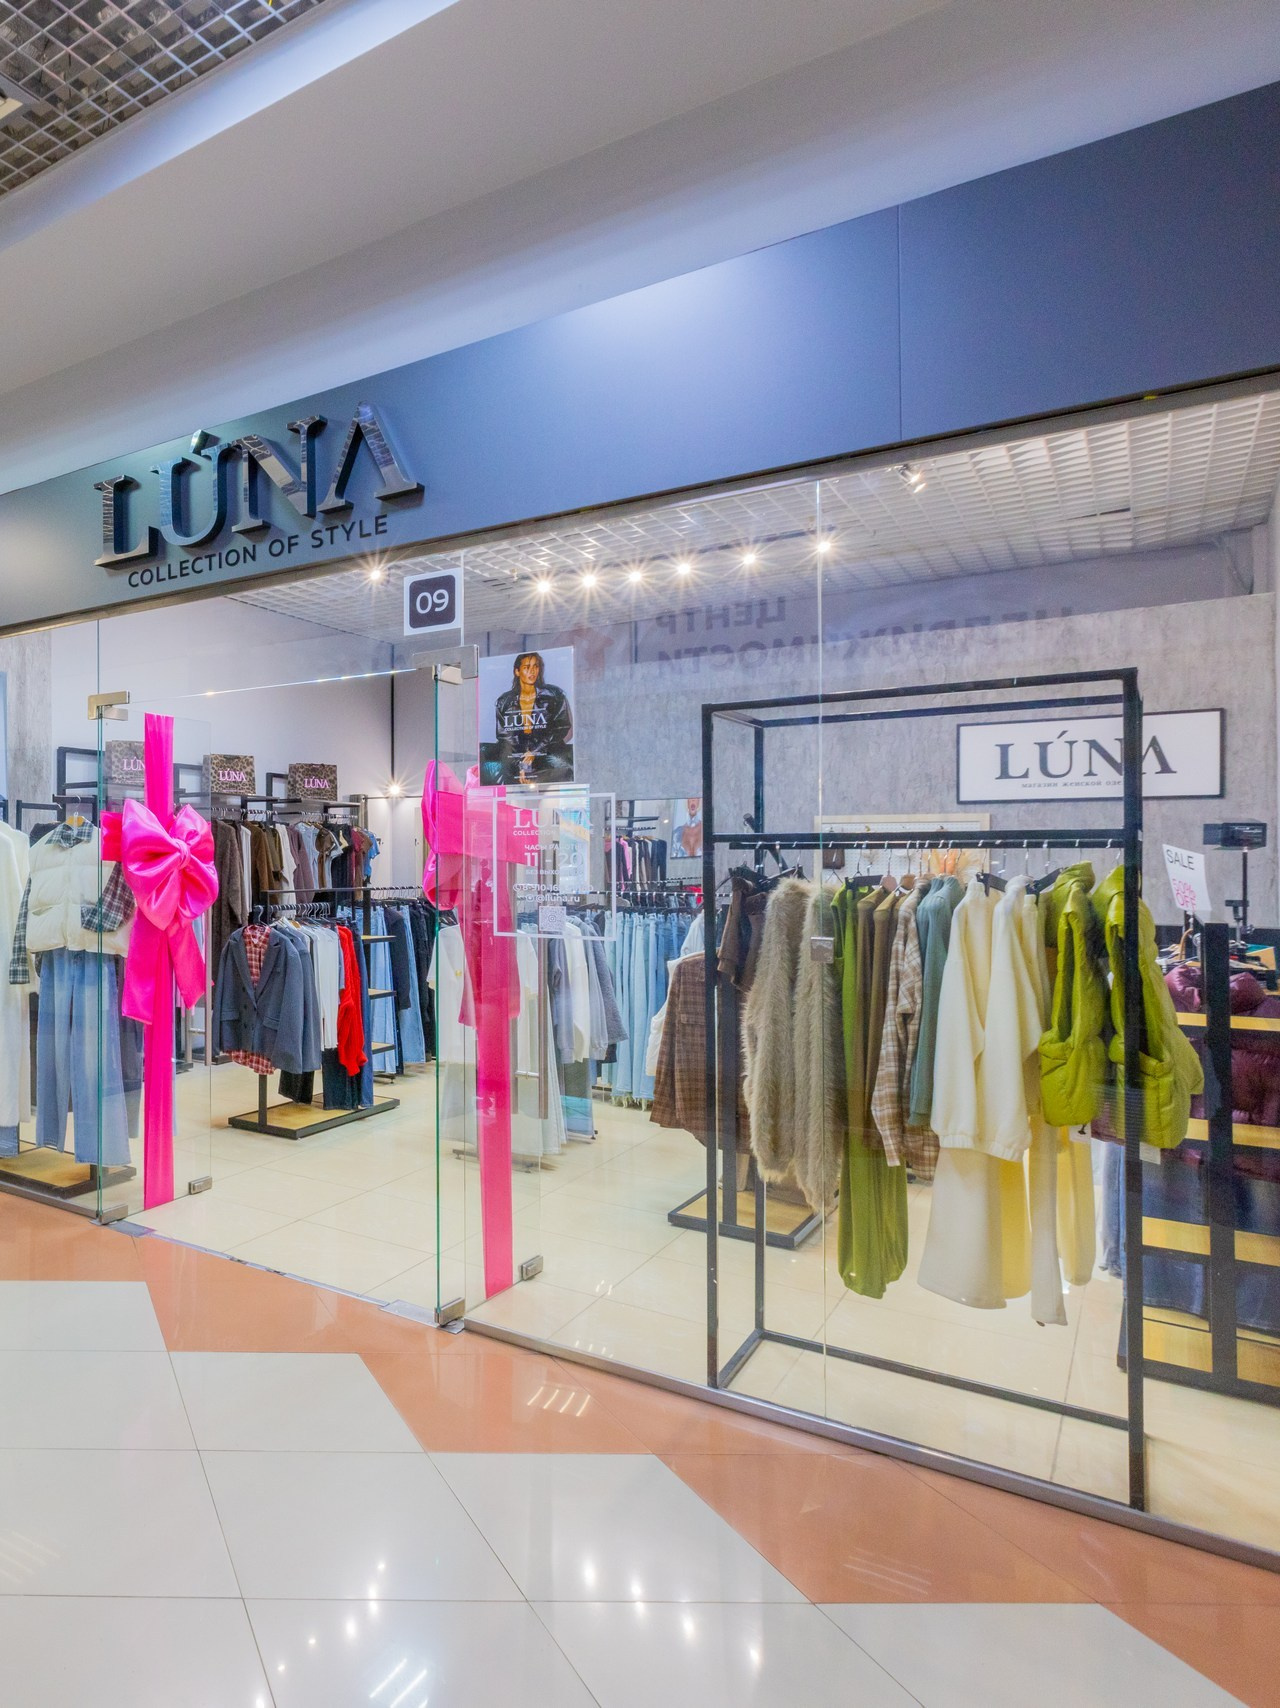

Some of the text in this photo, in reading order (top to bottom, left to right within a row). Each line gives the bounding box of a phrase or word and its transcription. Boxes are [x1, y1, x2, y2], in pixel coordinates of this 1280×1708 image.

[128, 514, 388, 588] COLLECTION OF STYLE
[416, 589, 449, 614] 09
[122, 756, 145, 770] LÚN
[524, 852, 538, 867] 11
[557, 852, 584, 867] 20
[1166, 849, 1195, 871] SALE
